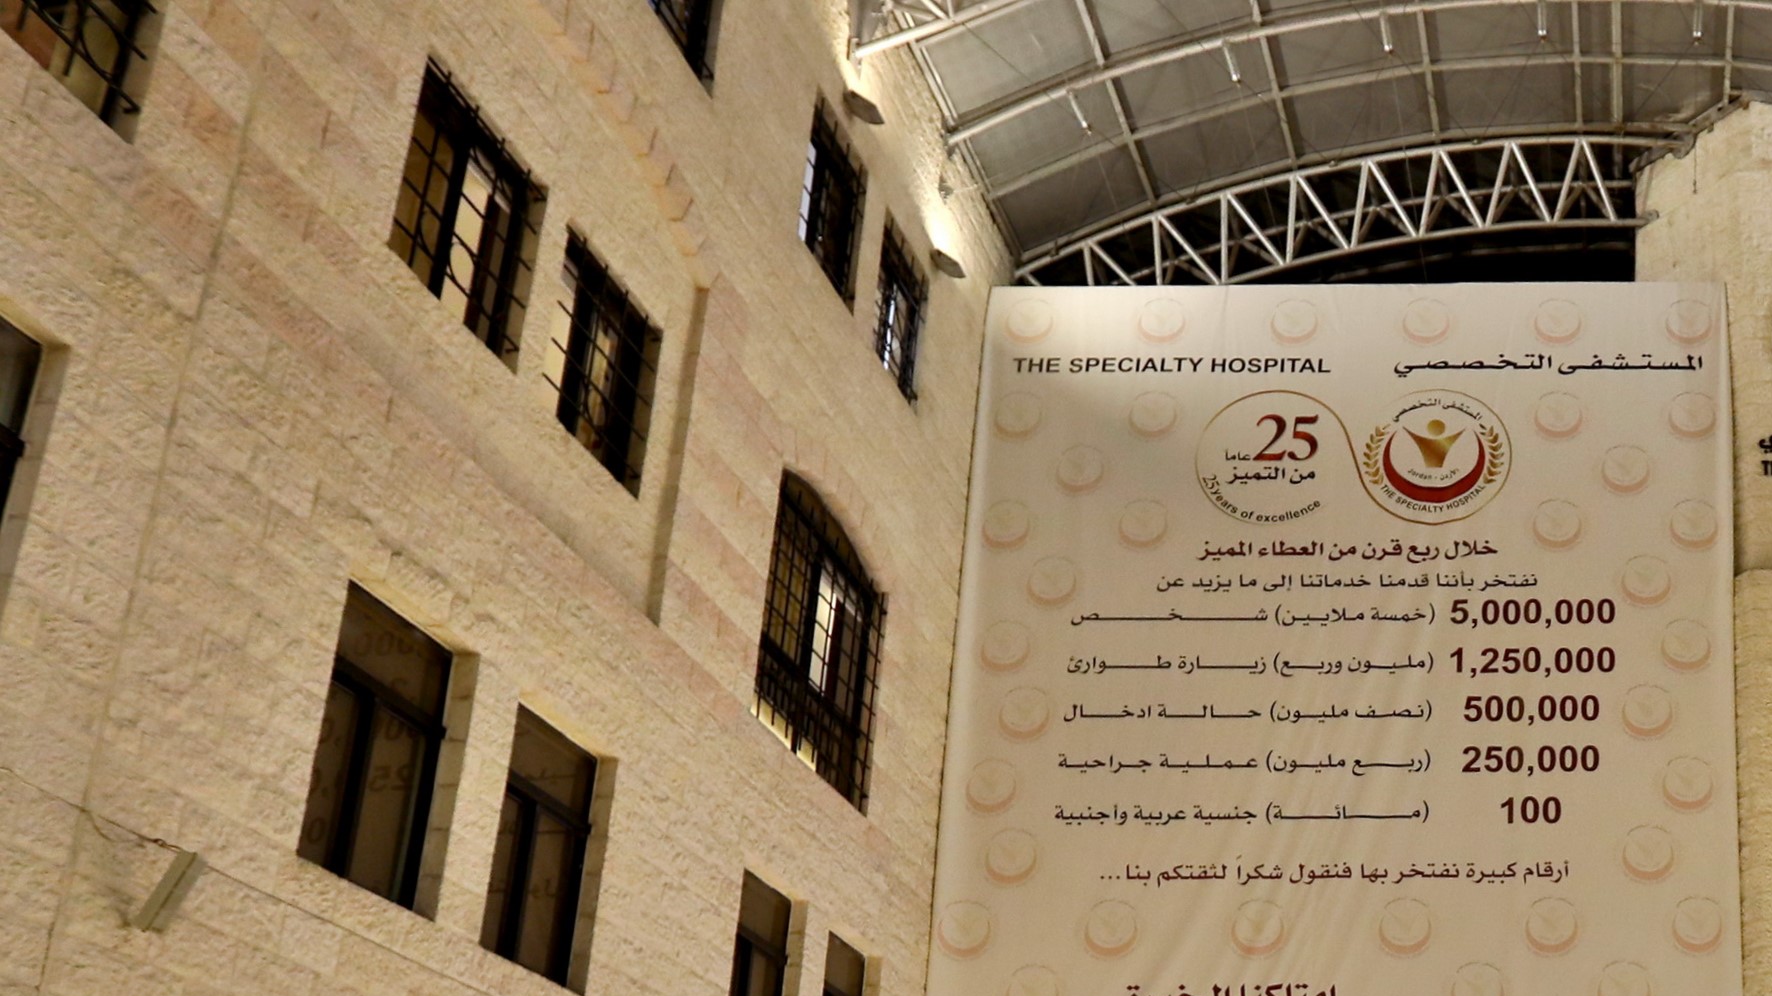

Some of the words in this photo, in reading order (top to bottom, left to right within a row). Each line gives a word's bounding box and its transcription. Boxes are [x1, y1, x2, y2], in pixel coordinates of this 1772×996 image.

[1013, 357, 1061, 373] THE
[1068, 357, 1204, 373] SPECIALTY
[1210, 357, 1332, 373] HOSPITAL
[1393, 353, 1553, 378] التخصصي
[1557, 353, 1704, 376] المستشفى
[1252, 412, 1320, 462] 25
[1225, 465, 1286, 485] التميز
[1289, 468, 1317, 485] من
[1380, 483, 1397, 500] THE
[1395, 496, 1445, 514] SPECIALTY
[1446, 483, 1487, 510] HOSPITAL
[1240, 509, 1256, 520] of
[1255, 498, 1322, 523] excellence
[1196, 540, 1252, 561] المميز
[1257, 541, 1325, 558] العطاء
[1328, 544, 1358, 561] من
[1361, 539, 1403, 560] قرن
[1406, 545, 1441, 563] ربع
[1444, 540, 1499, 560] خلال
[1156, 575, 1185, 592] عن
[1192, 574, 1232, 592] يزيد
[1239, 574, 1258, 588] ما
[1263, 574, 1293, 592] إلى
[1300, 572, 1371, 588] خدماتنا
[1379, 573, 1430, 588] قدمنا
[1436, 570, 1475, 591] بأننا
[1478, 573, 1539, 591] نفتخر
[1070, 607, 1269, 626] شخص
[1449, 599, 1616, 629] 5,000,000
[1066, 655, 1172, 674] طوارئ
[1177, 656, 1268, 674] زيارة
[1449, 647, 1616, 678] 1,250,000
[1063, 703, 1152, 723] ادخال
[1157, 704, 1262, 719] حالة
[1463, 695, 1600, 726] 500,000
[1057, 754, 1152, 774] جراحية
[1159, 754, 1258, 774] عملية
[1461, 745, 1600, 777] 250,000
[1054, 805, 1128, 825] وأجنبية
[1133, 805, 1187, 825] عربية
[1193, 805, 1257, 826] جنسية
[1500, 796, 1562, 824] 100
[1156, 864, 1227, 887] لثقتكم
[1289, 862, 1352, 884] فنقول
[1360, 864, 1388, 884] بها
[1391, 862, 1460, 884] نفتخر
[1465, 862, 1517, 883] كبيرة
[1523, 861, 1569, 884] أرقام
